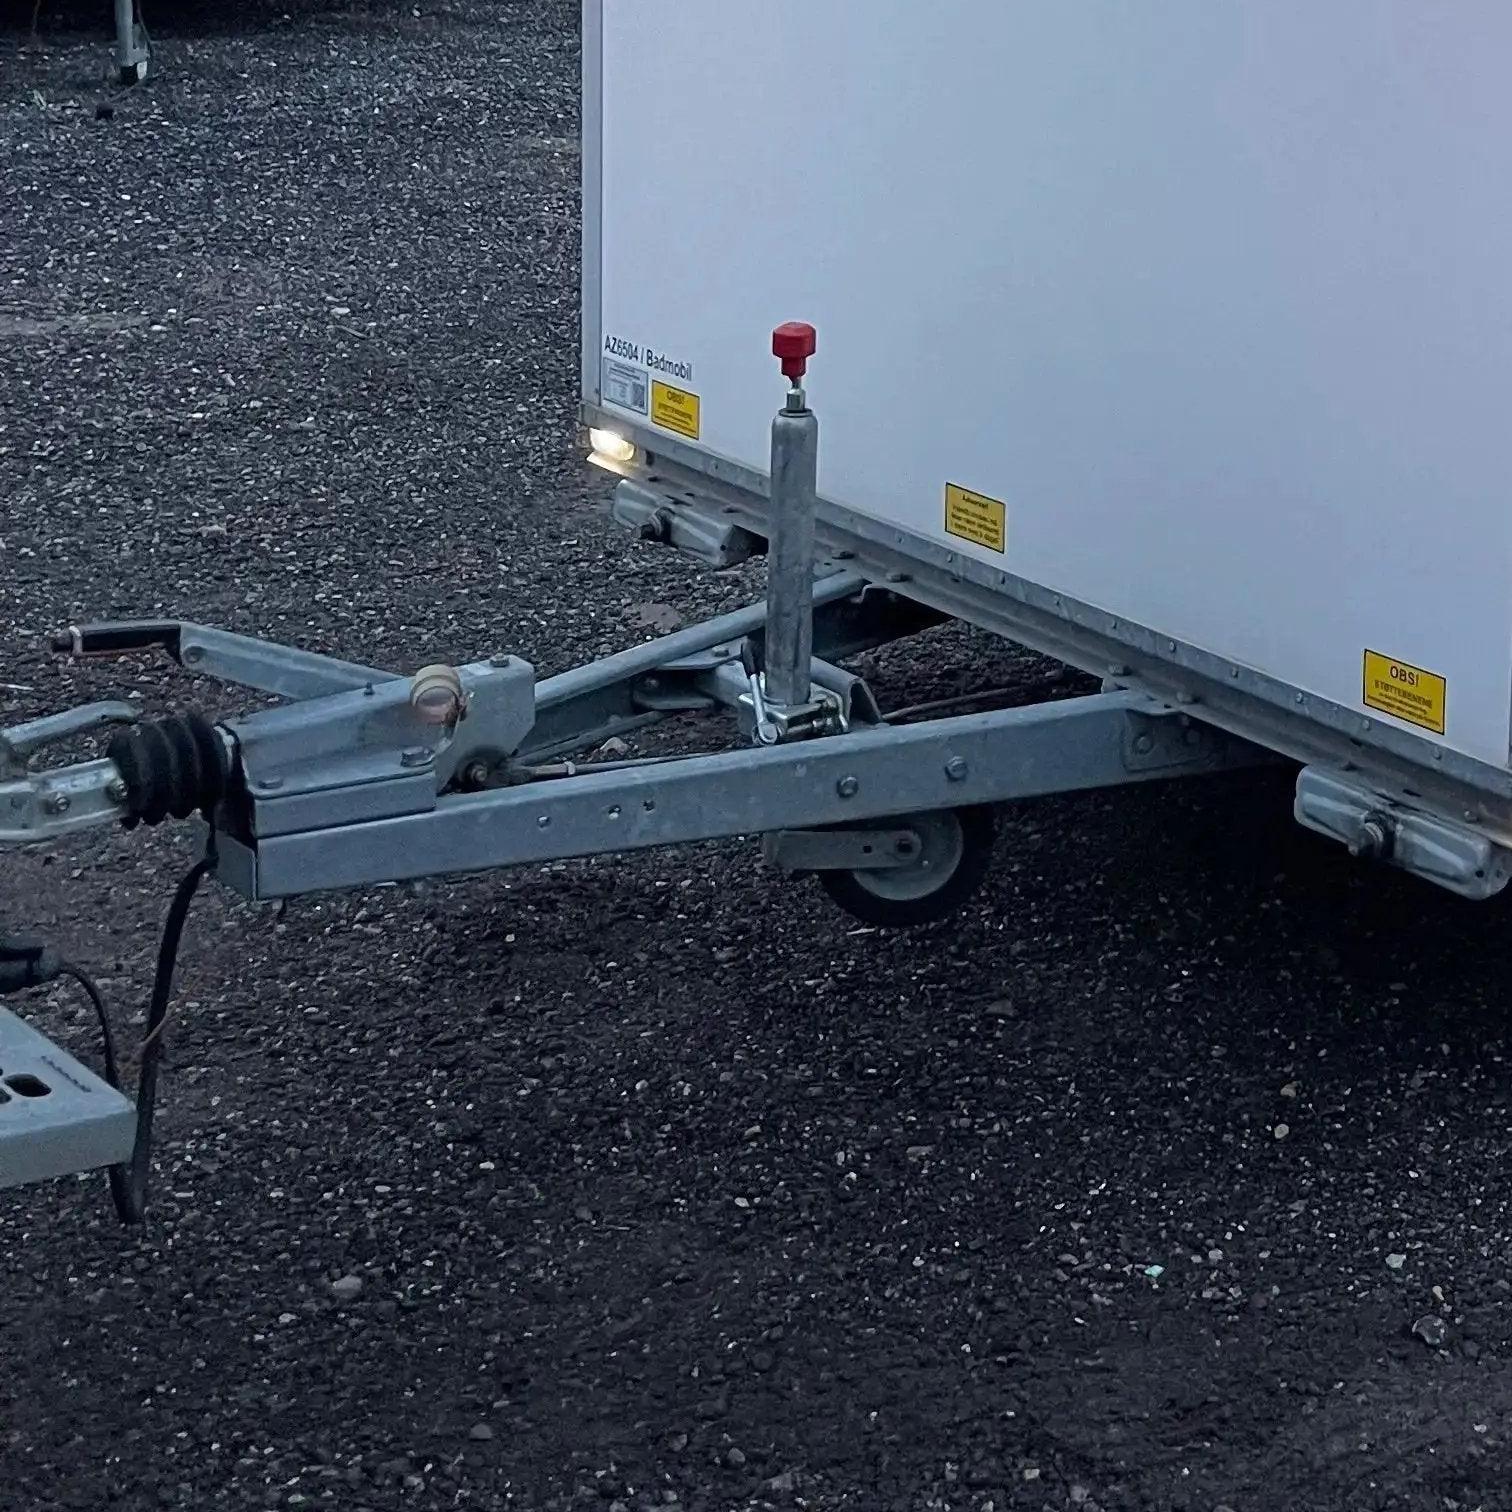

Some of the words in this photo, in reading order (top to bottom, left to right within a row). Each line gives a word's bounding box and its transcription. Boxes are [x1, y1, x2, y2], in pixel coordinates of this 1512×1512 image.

[604, 335, 639, 361] AZ6504
[646, 348, 692, 381] Badmobil
[1389, 665, 1419, 687] OBS!
